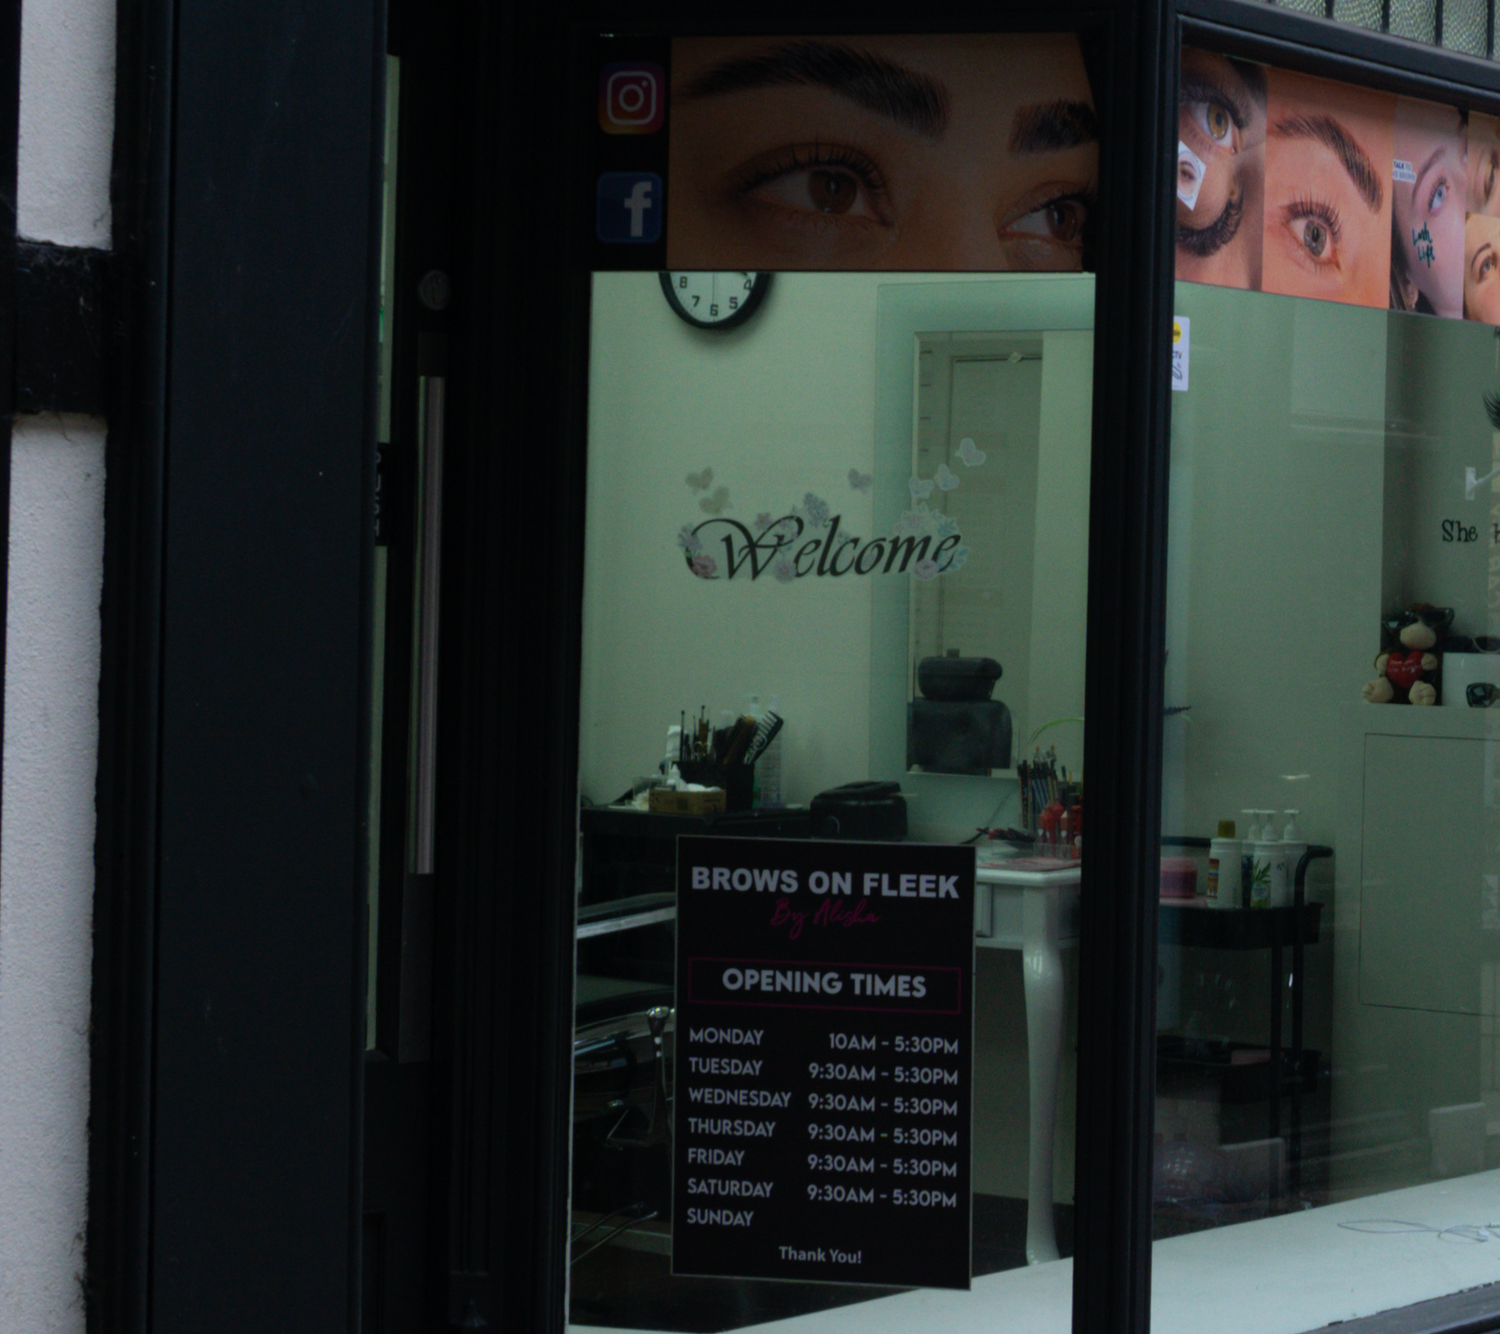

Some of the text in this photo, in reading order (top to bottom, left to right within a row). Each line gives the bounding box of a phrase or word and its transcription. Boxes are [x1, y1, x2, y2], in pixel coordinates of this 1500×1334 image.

[1441, 519, 1478, 543] She
[682, 515, 964, 582] Welcome
[691, 865, 960, 900] BROWS ON FLEEK
[721, 968, 927, 998] OPENING TIMES
[688, 1027, 959, 1055] MONDAY 10AM 5:30PM
[688, 1057, 959, 1085] TUESDAY 9:30AM 5:30PM
[688, 1088, 959, 1116] WEDNESDAY 9:30AM 5:30PM
[688, 1118, 959, 1146] THURSDAY 9:30AM 5:30PM
[688, 1148, 959, 1177] FRIDAY 9:30AM 5:30PM
[688, 1178, 959, 1208] SATURDAY 9:30AM 5:30PM
[686, 1207, 754, 1228] SUNDAY
[779, 1245, 862, 1265] Thank You!
